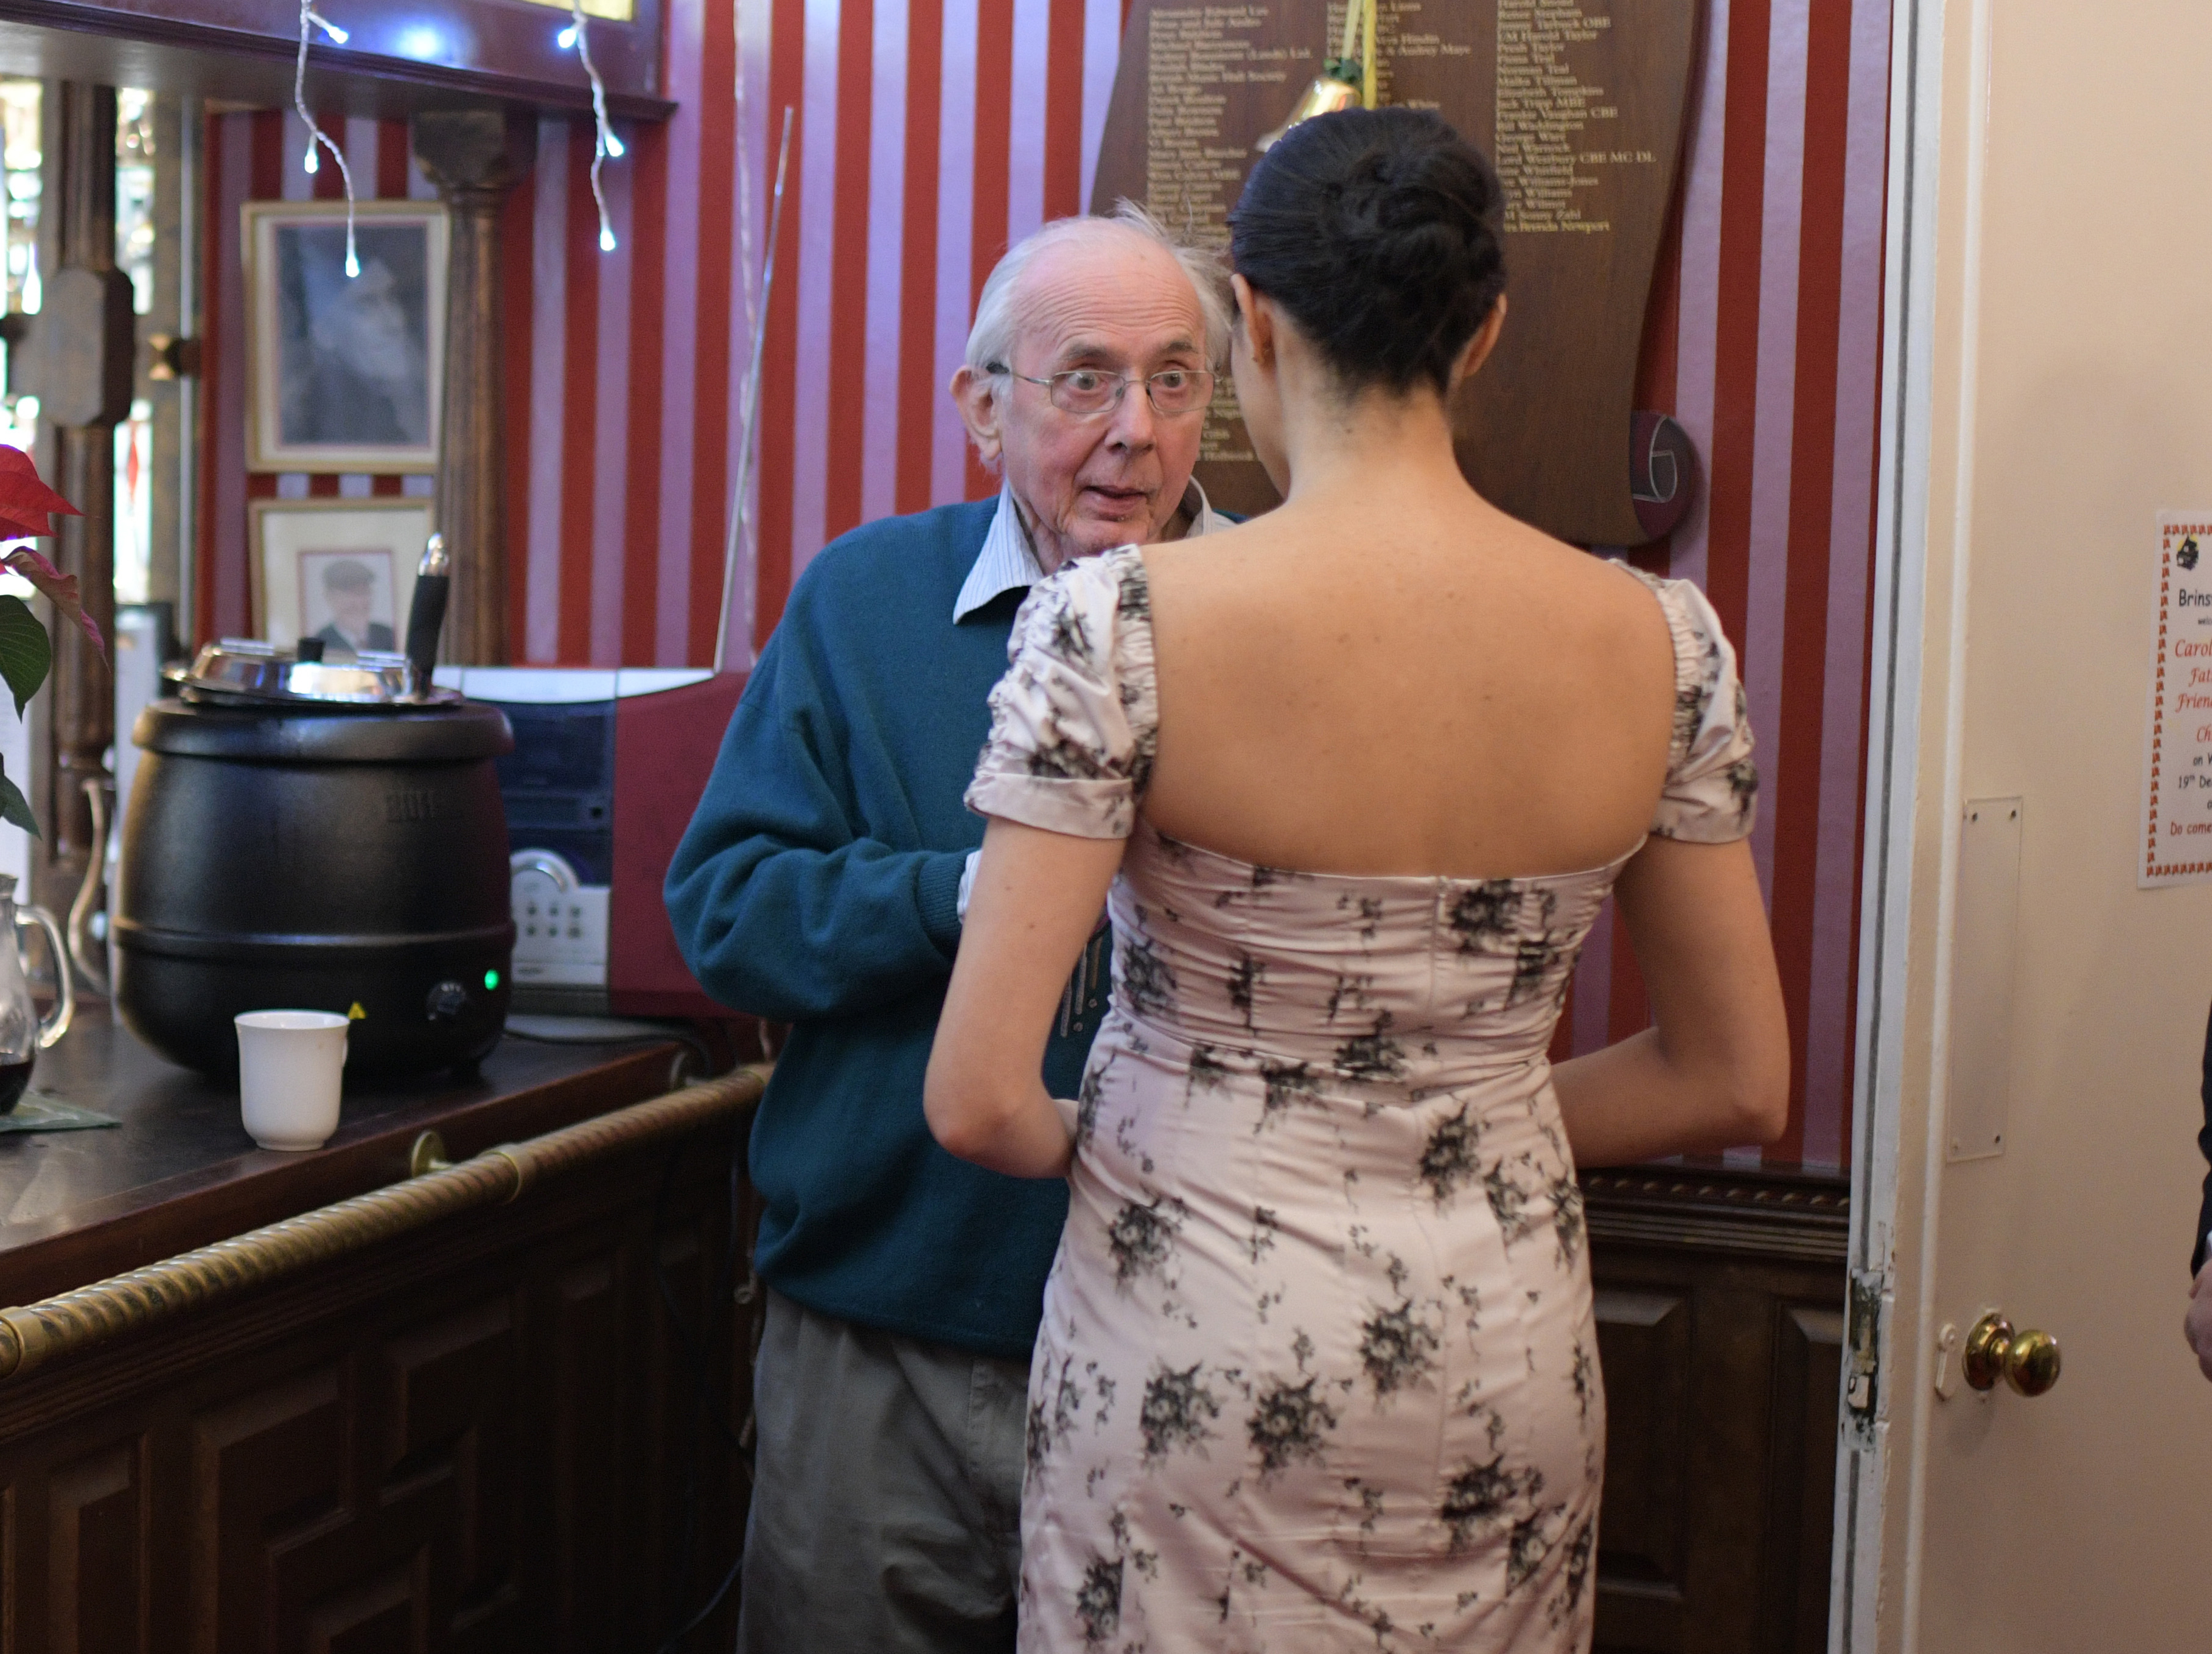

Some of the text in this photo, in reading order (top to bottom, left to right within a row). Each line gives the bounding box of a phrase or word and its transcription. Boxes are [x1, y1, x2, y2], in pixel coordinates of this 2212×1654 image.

[1580, 152, 1607, 164] CBE
[1611, 151, 1633, 163] MC
[2179, 588, 2212, 607] Brins
[2175, 693, 2212, 713] Frien
[2170, 821, 2212, 836] Do come
